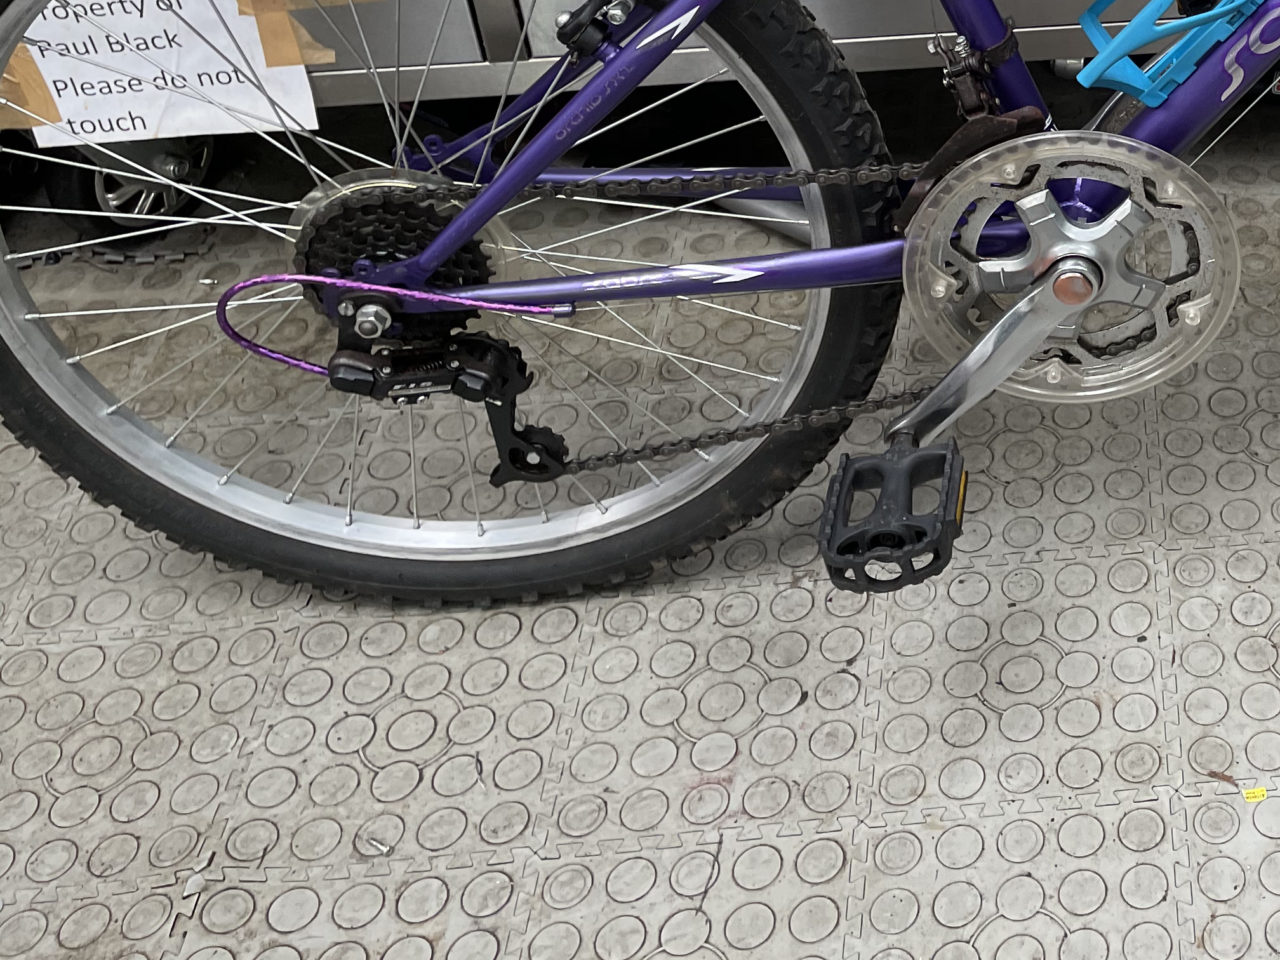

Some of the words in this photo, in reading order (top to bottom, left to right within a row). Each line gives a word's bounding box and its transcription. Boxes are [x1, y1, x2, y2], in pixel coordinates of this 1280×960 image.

[36, 35, 99, 59] Paul
[105, 28, 184, 54] Black
[52, 74, 144, 99] Please
[152, 69, 188, 92] do
[197, 66, 246, 89] not
[66, 110, 148, 136] touch
